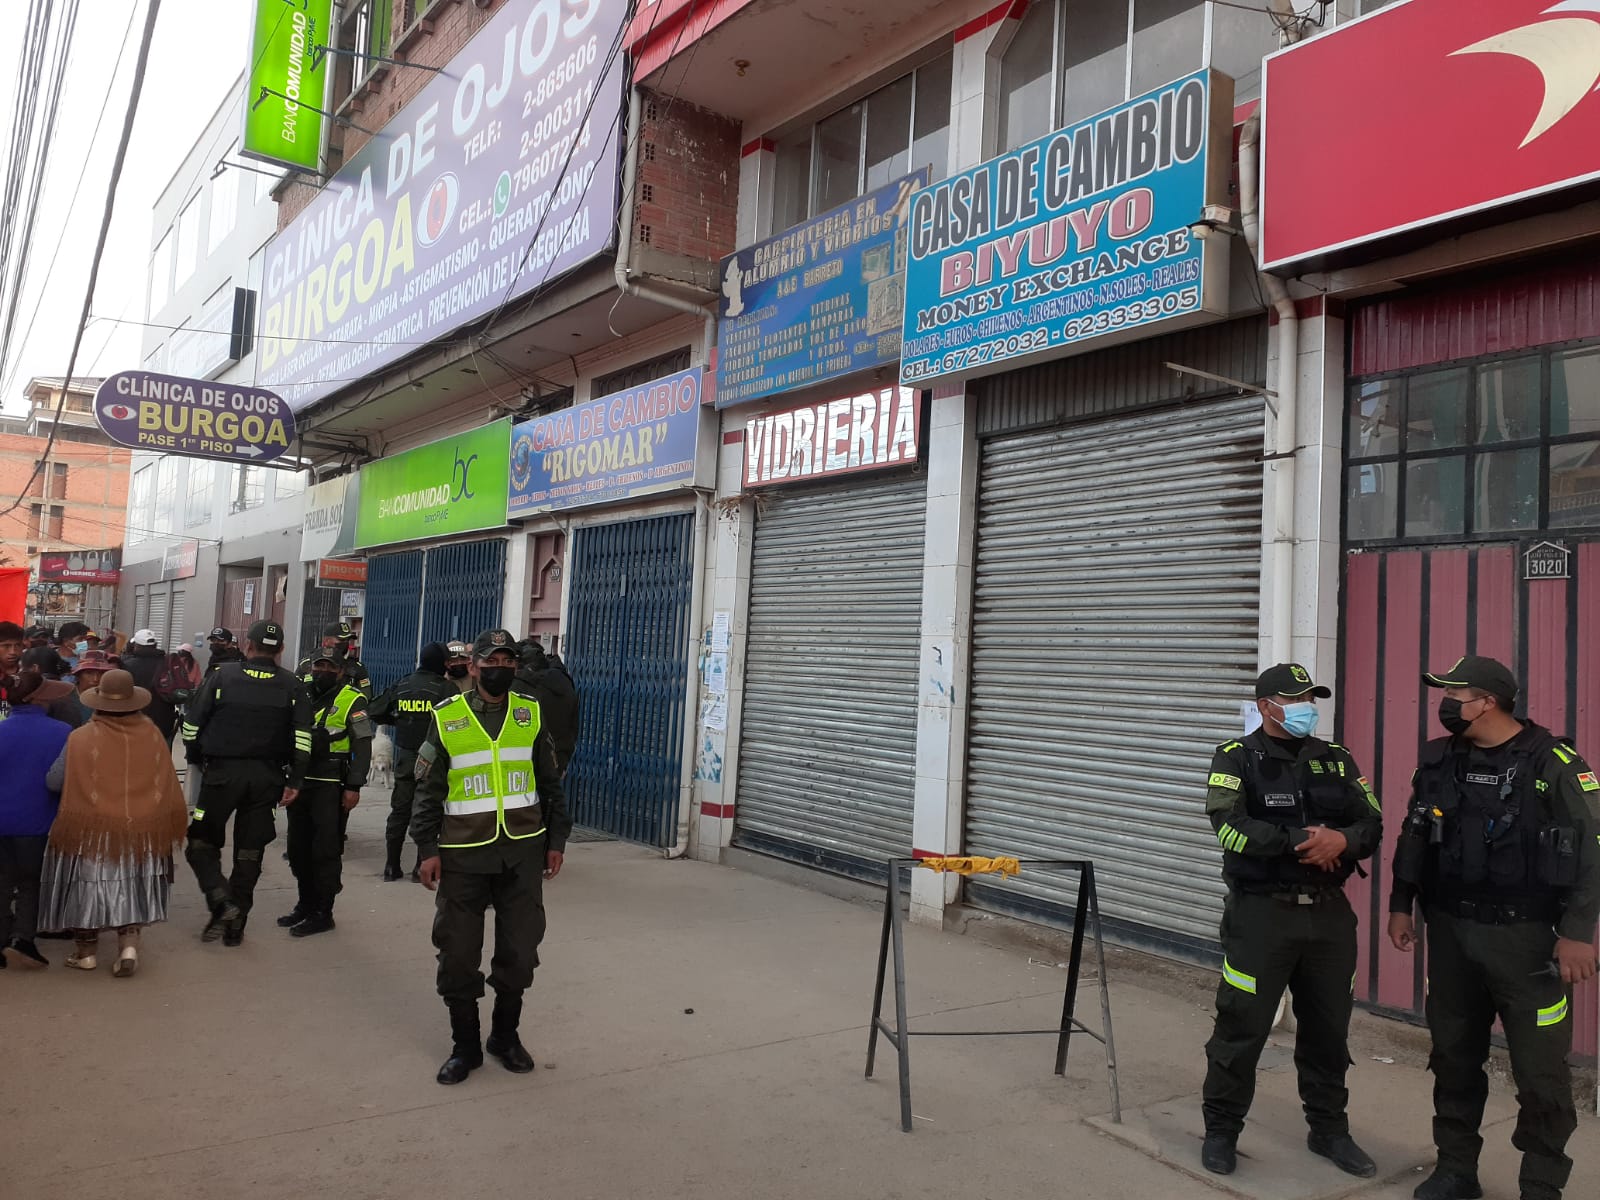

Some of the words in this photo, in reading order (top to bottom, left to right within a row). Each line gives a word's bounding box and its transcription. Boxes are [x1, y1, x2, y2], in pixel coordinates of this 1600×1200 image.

[282, 11, 306, 143] BANCOMUNIDAD
[519, 80, 593, 160] 2-900311
[522, 35, 597, 119] 2-865606
[268, 164, 374, 299] CLÍNICA
[385, 101, 439, 200] DE
[489, 160, 595, 251] QUERATOCONO
[856, 198, 877, 223] EN
[911, 167, 992, 262] CASA
[995, 144, 1040, 231] DE
[1044, 77, 1206, 212] CAMBIO
[427, 264, 490, 329] PREVENCIÓN
[492, 255, 509, 293] DE
[510, 245, 525, 283] LA
[528, 206, 590, 273] CEGUERA
[811, 241, 820, 261] Y
[825, 210, 893, 255] VIDRIOS
[916, 283, 1009, 332] MONEY
[1011, 227, 1189, 304] EXCHANGE
[940, 187, 1155, 298] BIYUYO
[262, 192, 414, 372] BURGOA
[903, 333, 940, 359] DOLARES
[944, 323, 973, 349] EUROS
[977, 309, 1023, 339] CHILENOS
[1027, 288, 1095, 326] ARGENTINOS
[1151, 258, 1200, 291] REALES
[902, 358, 940, 381] CEL.:
[942, 327, 1048, 371] 67272032
[1064, 286, 1198, 339] 62333305
[116, 376, 196, 404] CLÍNICA
[201, 388, 226, 408] DE
[231, 393, 280, 415] OJOS
[138, 400, 288, 447] BURGOA
[532, 411, 575, 453] CASA
[579, 403, 606, 441] DE
[609, 374, 697, 432] CAMBIO
[746, 386, 917, 484] VIDRIERIA
[138, 432, 176, 447] PASE
[200, 440, 233, 454] PISO
[1531, 560, 1562, 575] 3020
[398, 699, 433, 712] POLICIA
